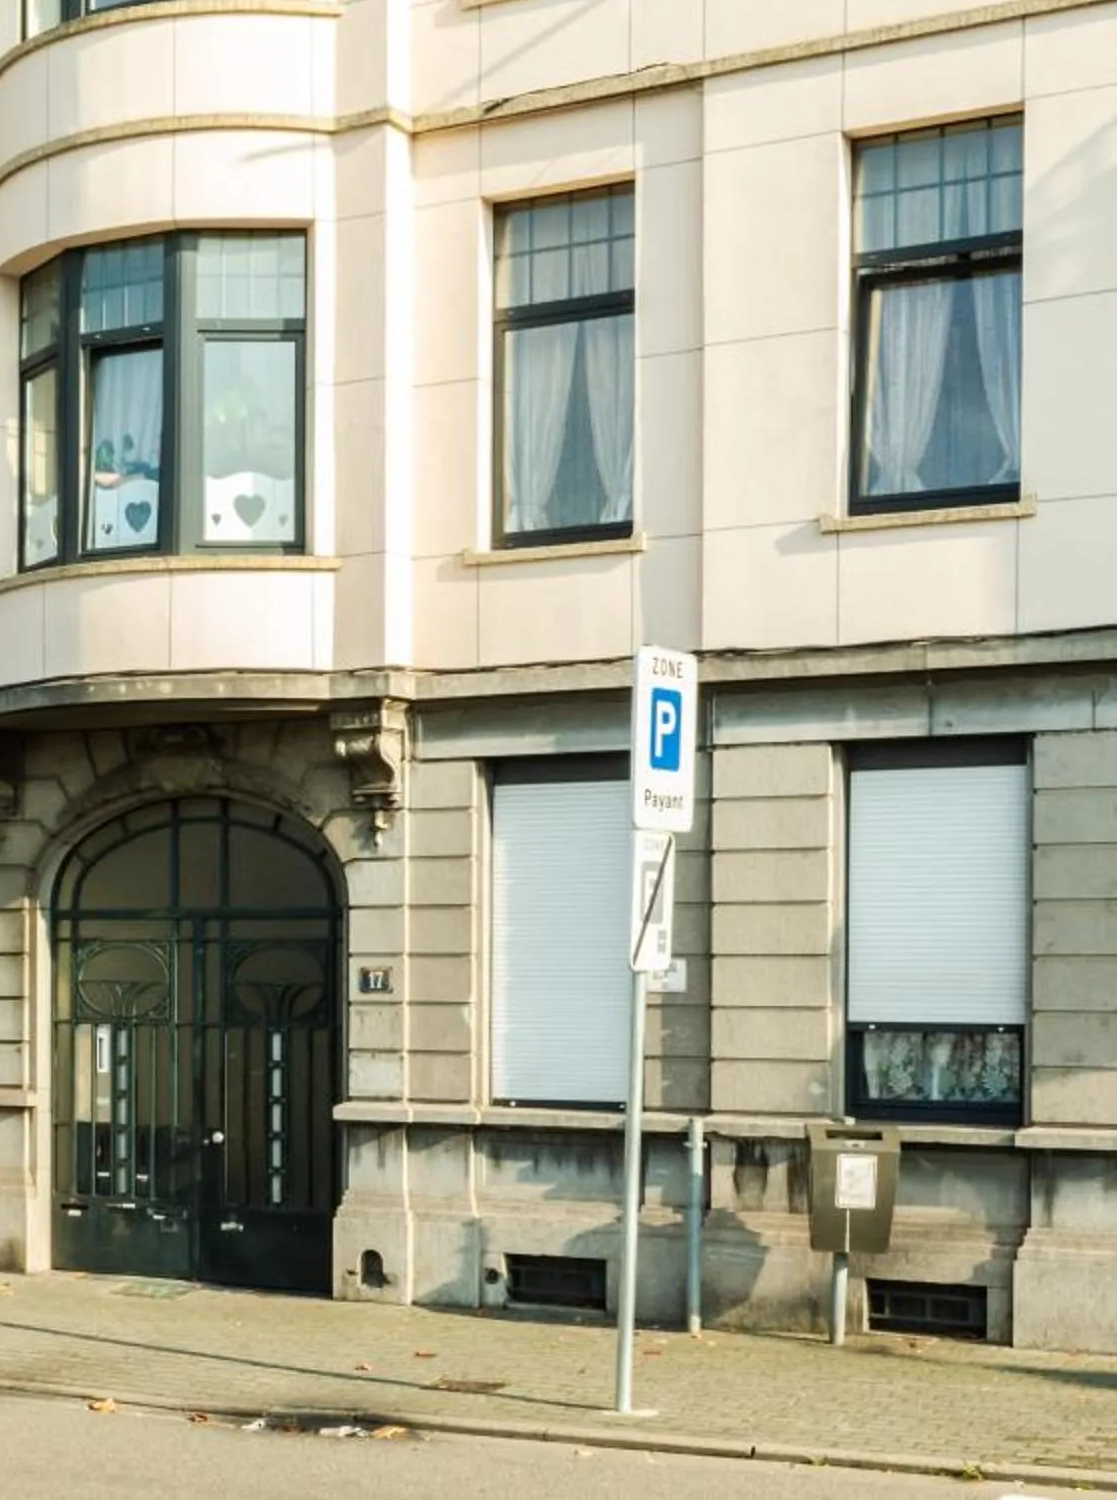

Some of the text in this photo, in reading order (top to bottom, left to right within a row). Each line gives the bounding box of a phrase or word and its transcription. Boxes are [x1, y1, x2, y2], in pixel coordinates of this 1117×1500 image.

[652, 657, 683, 679] ZONE
[655, 701, 677, 757] P
[644, 789, 684, 811] Payant
[369, 971, 384, 989] 17
